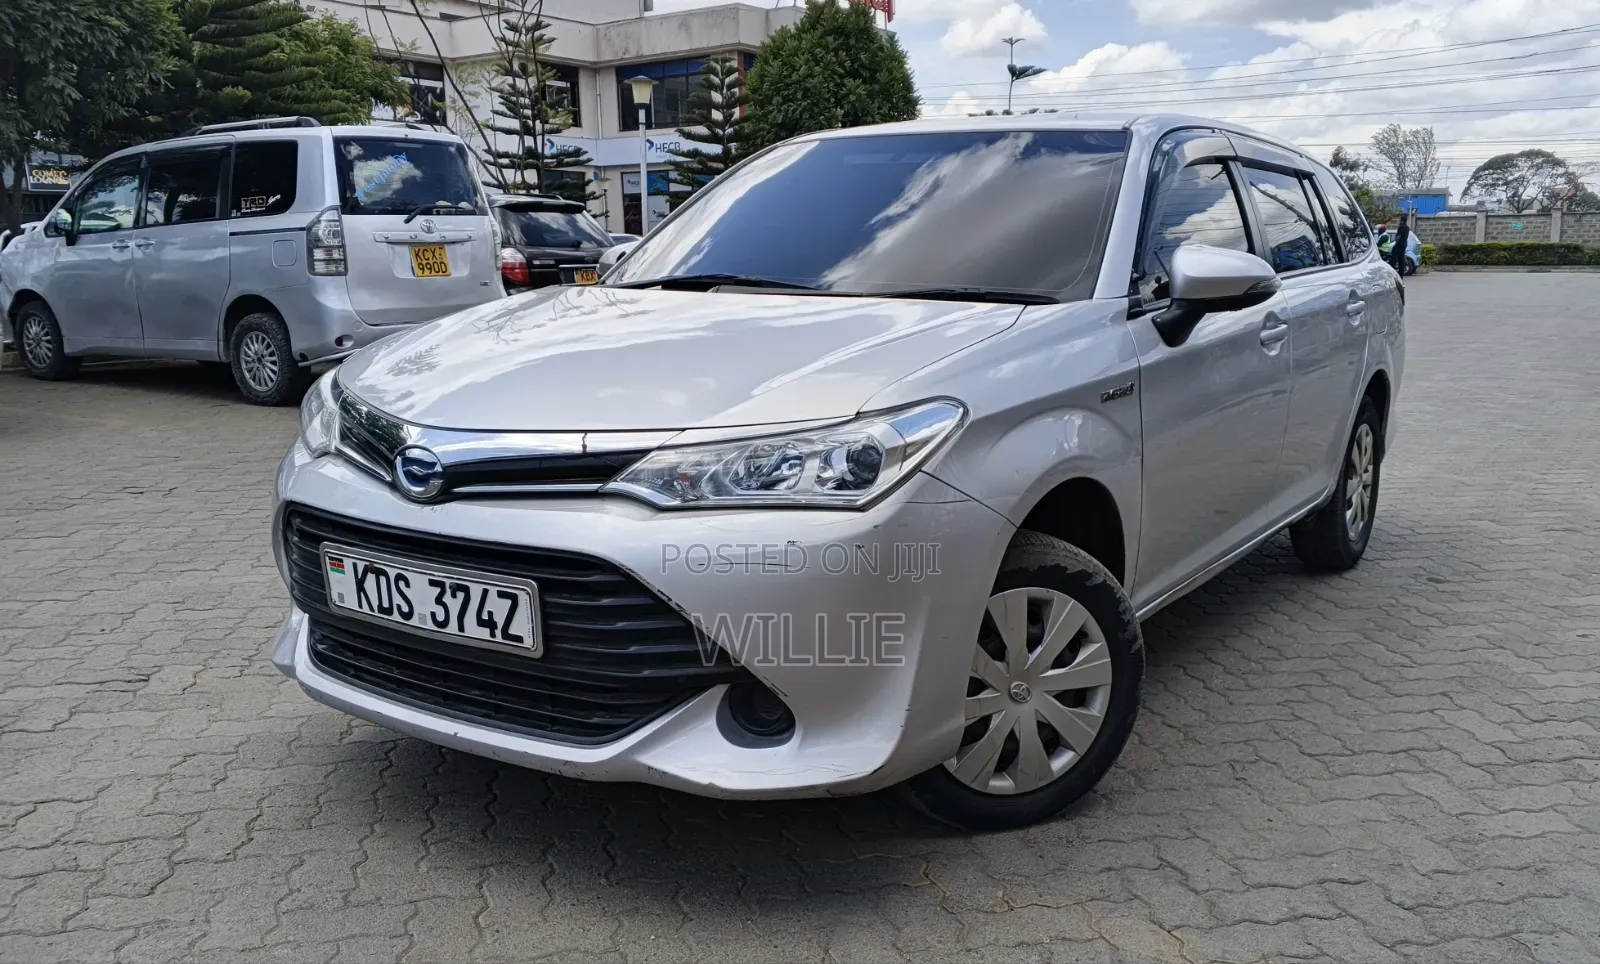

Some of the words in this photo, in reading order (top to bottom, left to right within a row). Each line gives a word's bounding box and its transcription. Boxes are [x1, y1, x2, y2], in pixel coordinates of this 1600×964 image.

[655, 142, 681, 153] HFCB
[30, 176, 69, 184] LOUNG
[414, 248, 437, 262] KCX
[352, 561, 414, 621] KDS
[427, 578, 524, 644] 374Z
